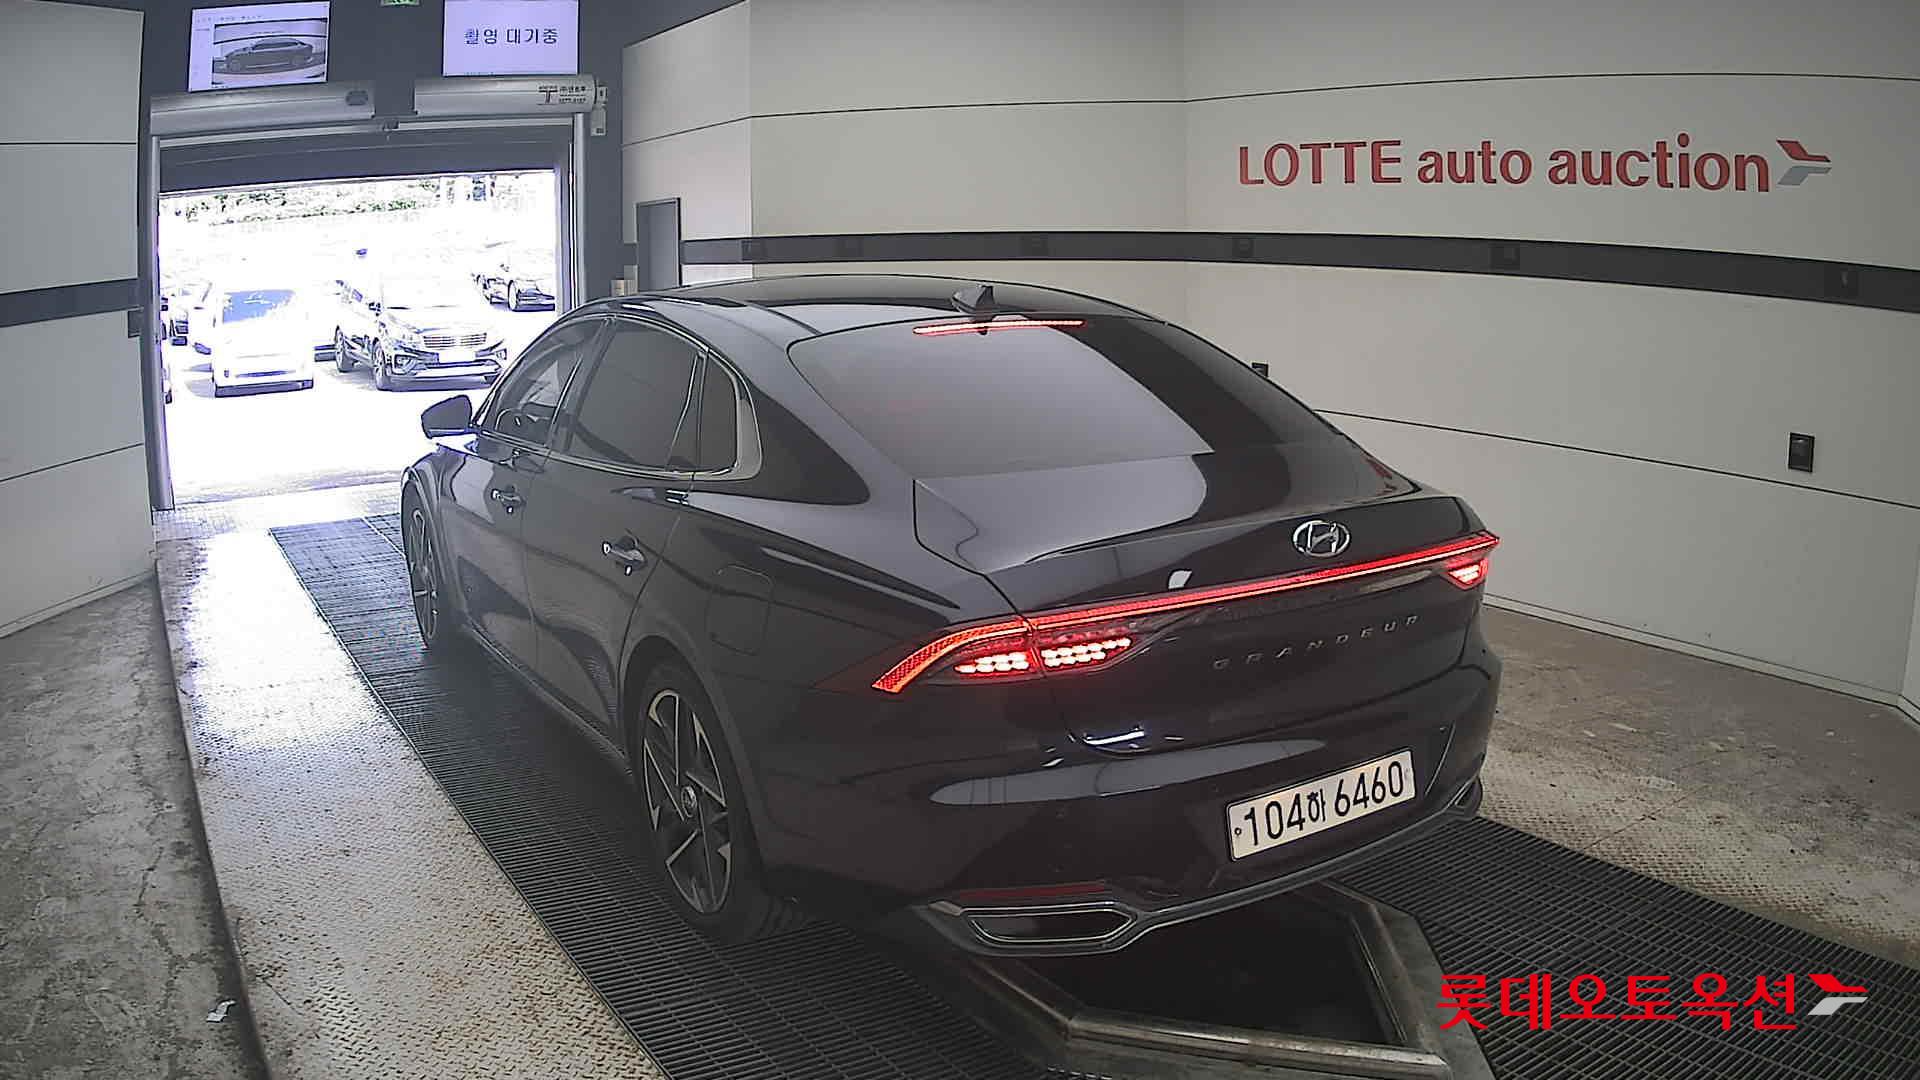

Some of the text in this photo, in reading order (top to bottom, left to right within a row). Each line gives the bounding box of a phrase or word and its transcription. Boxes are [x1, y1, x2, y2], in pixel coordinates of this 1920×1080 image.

[506, 28, 559, 45] 대기중
[1238, 132, 1770, 193] LOTTE auto auction
[1212, 614, 1418, 670] GRANDEUR
